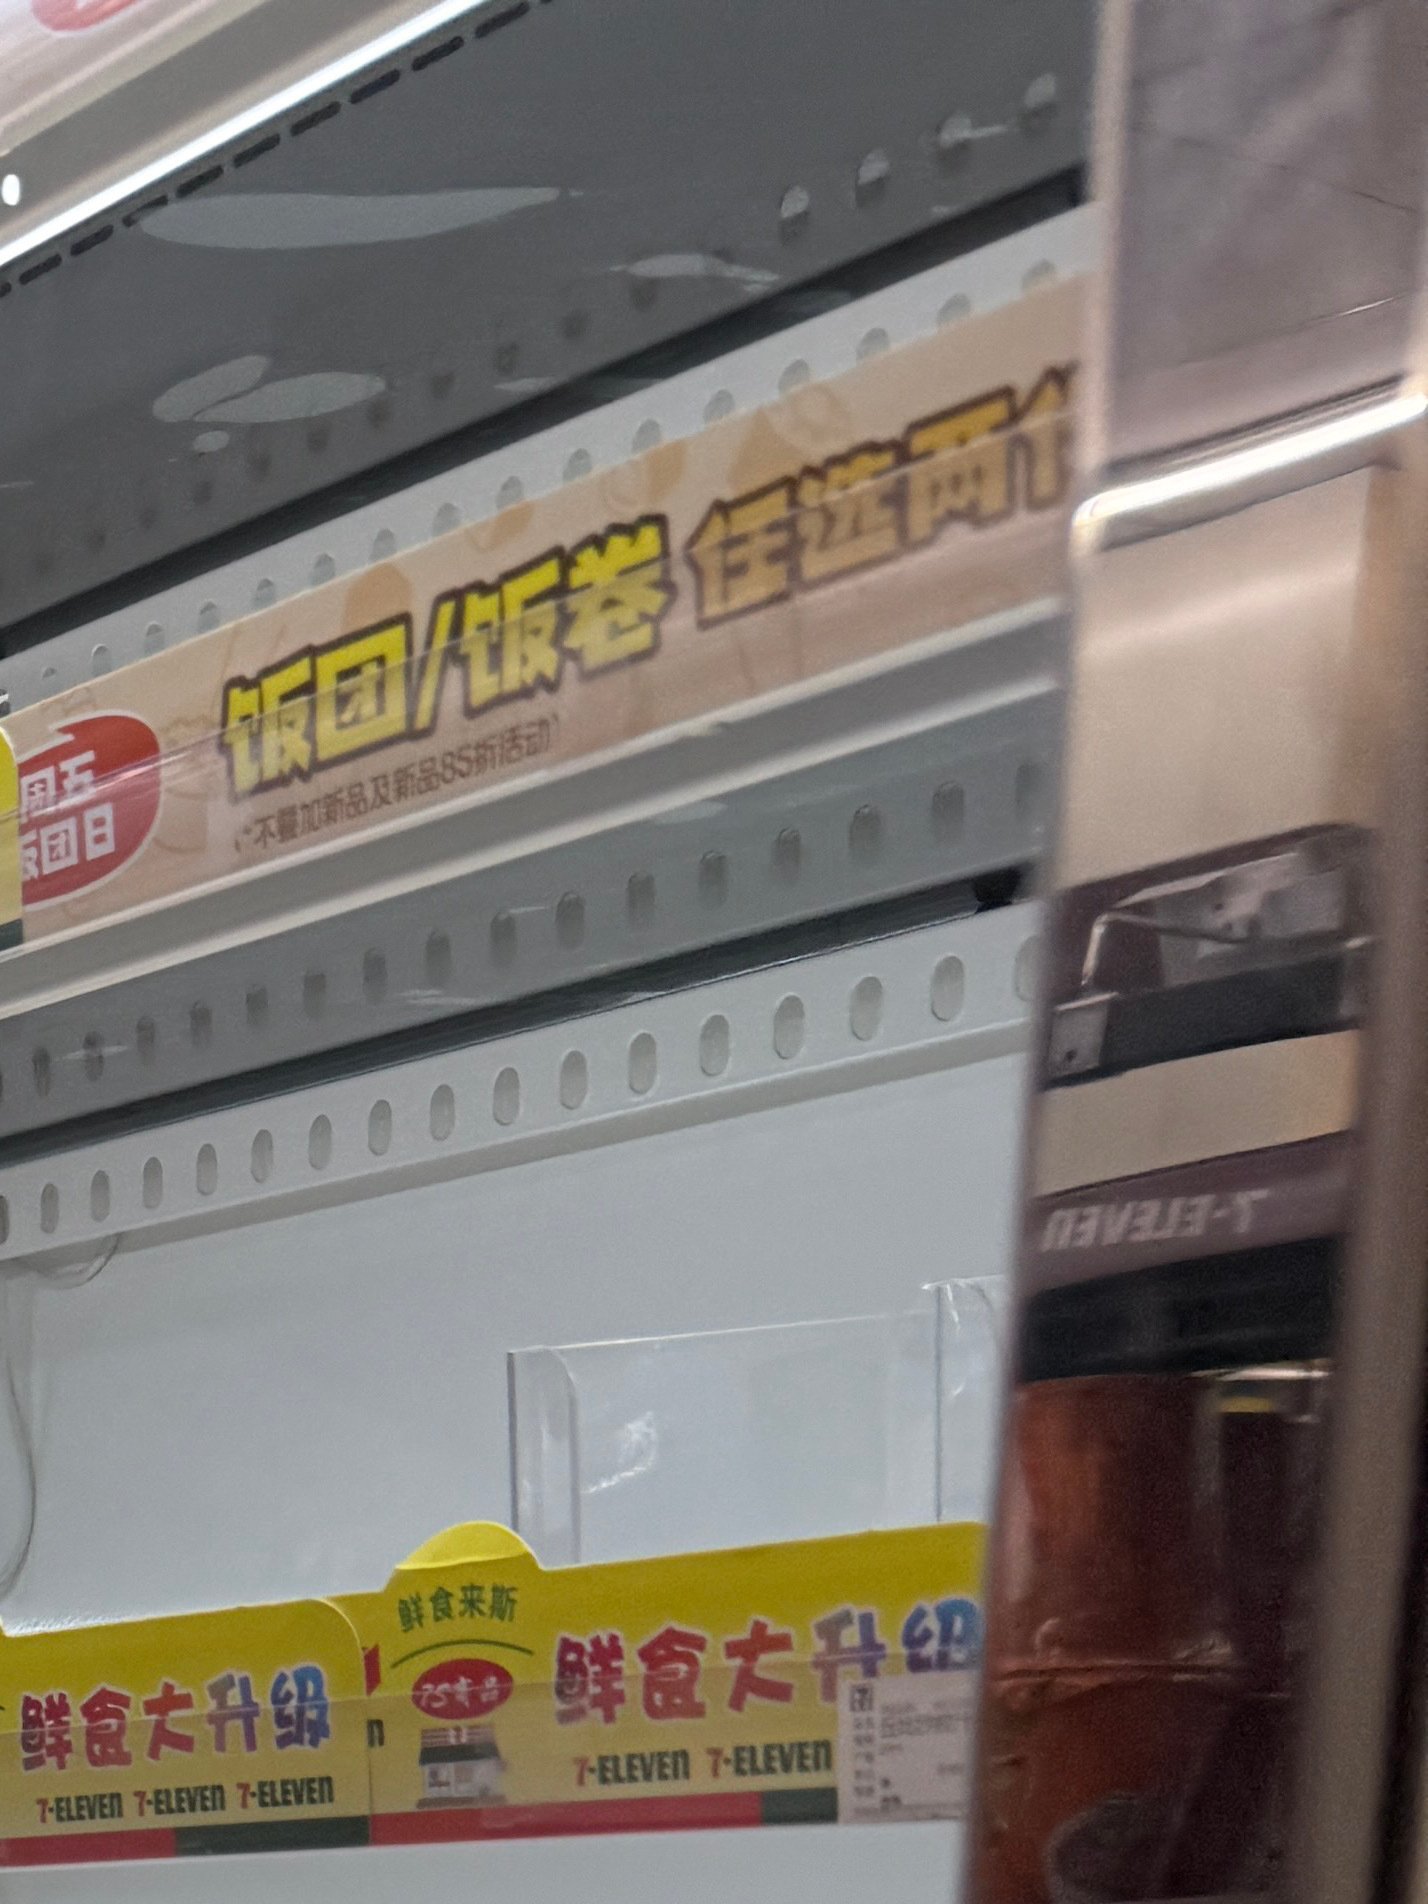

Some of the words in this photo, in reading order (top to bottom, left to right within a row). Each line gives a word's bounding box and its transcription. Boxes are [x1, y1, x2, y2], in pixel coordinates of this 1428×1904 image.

[221, 512, 673, 798] 饭团/饭卷
[398, 1585, 518, 1633] 鲜食来斯
[20, 1664, 330, 1772] 鲜食大升级
